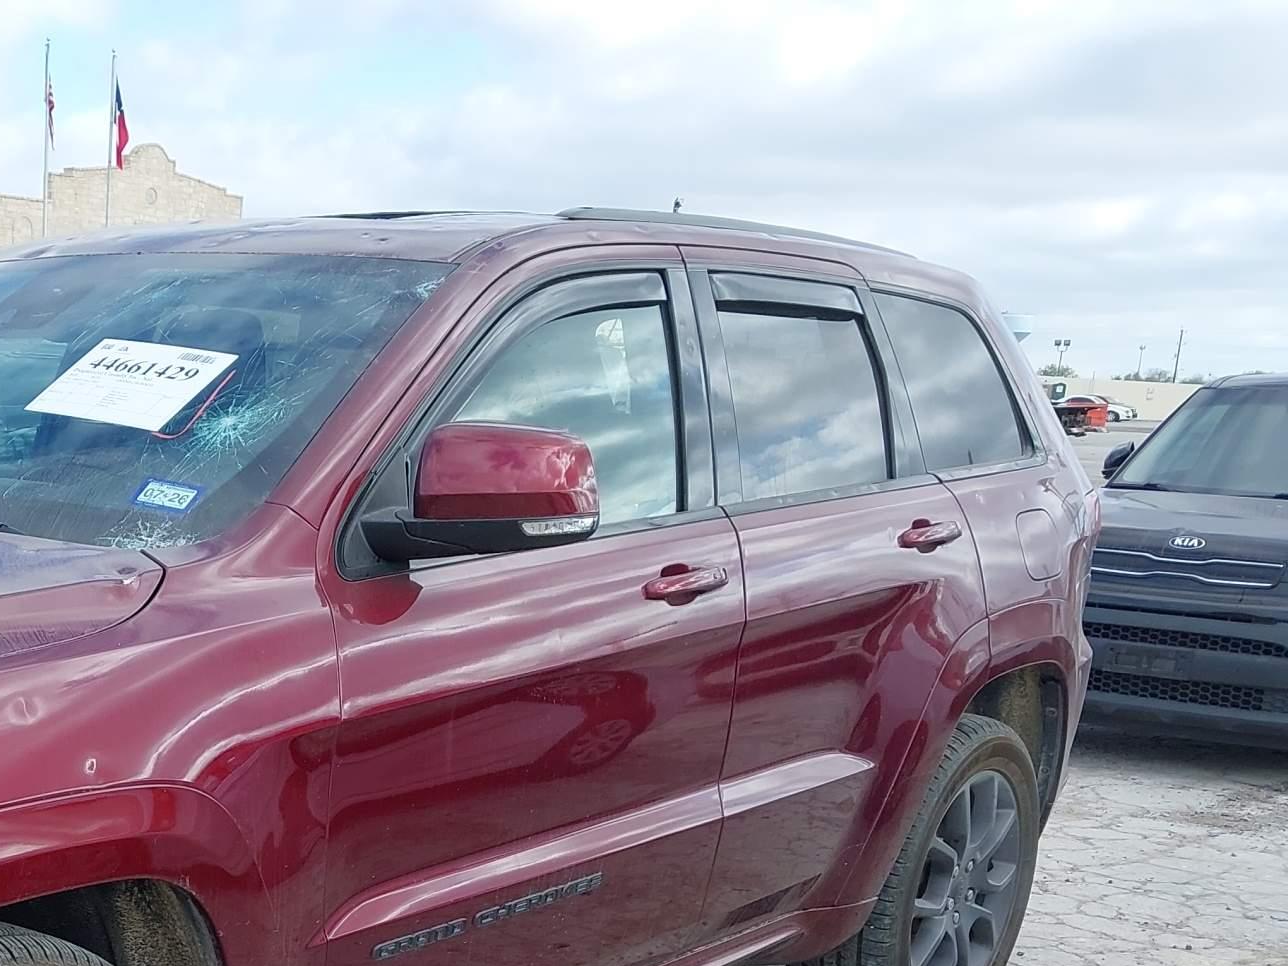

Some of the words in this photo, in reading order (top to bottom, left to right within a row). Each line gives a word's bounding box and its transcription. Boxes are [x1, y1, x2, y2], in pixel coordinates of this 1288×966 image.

[89, 356, 200, 381] 44661429
[1173, 536, 1199, 548] KIA
[372, 917, 468, 961] GRAND
[472, 872, 603, 928] CHEROKEE
